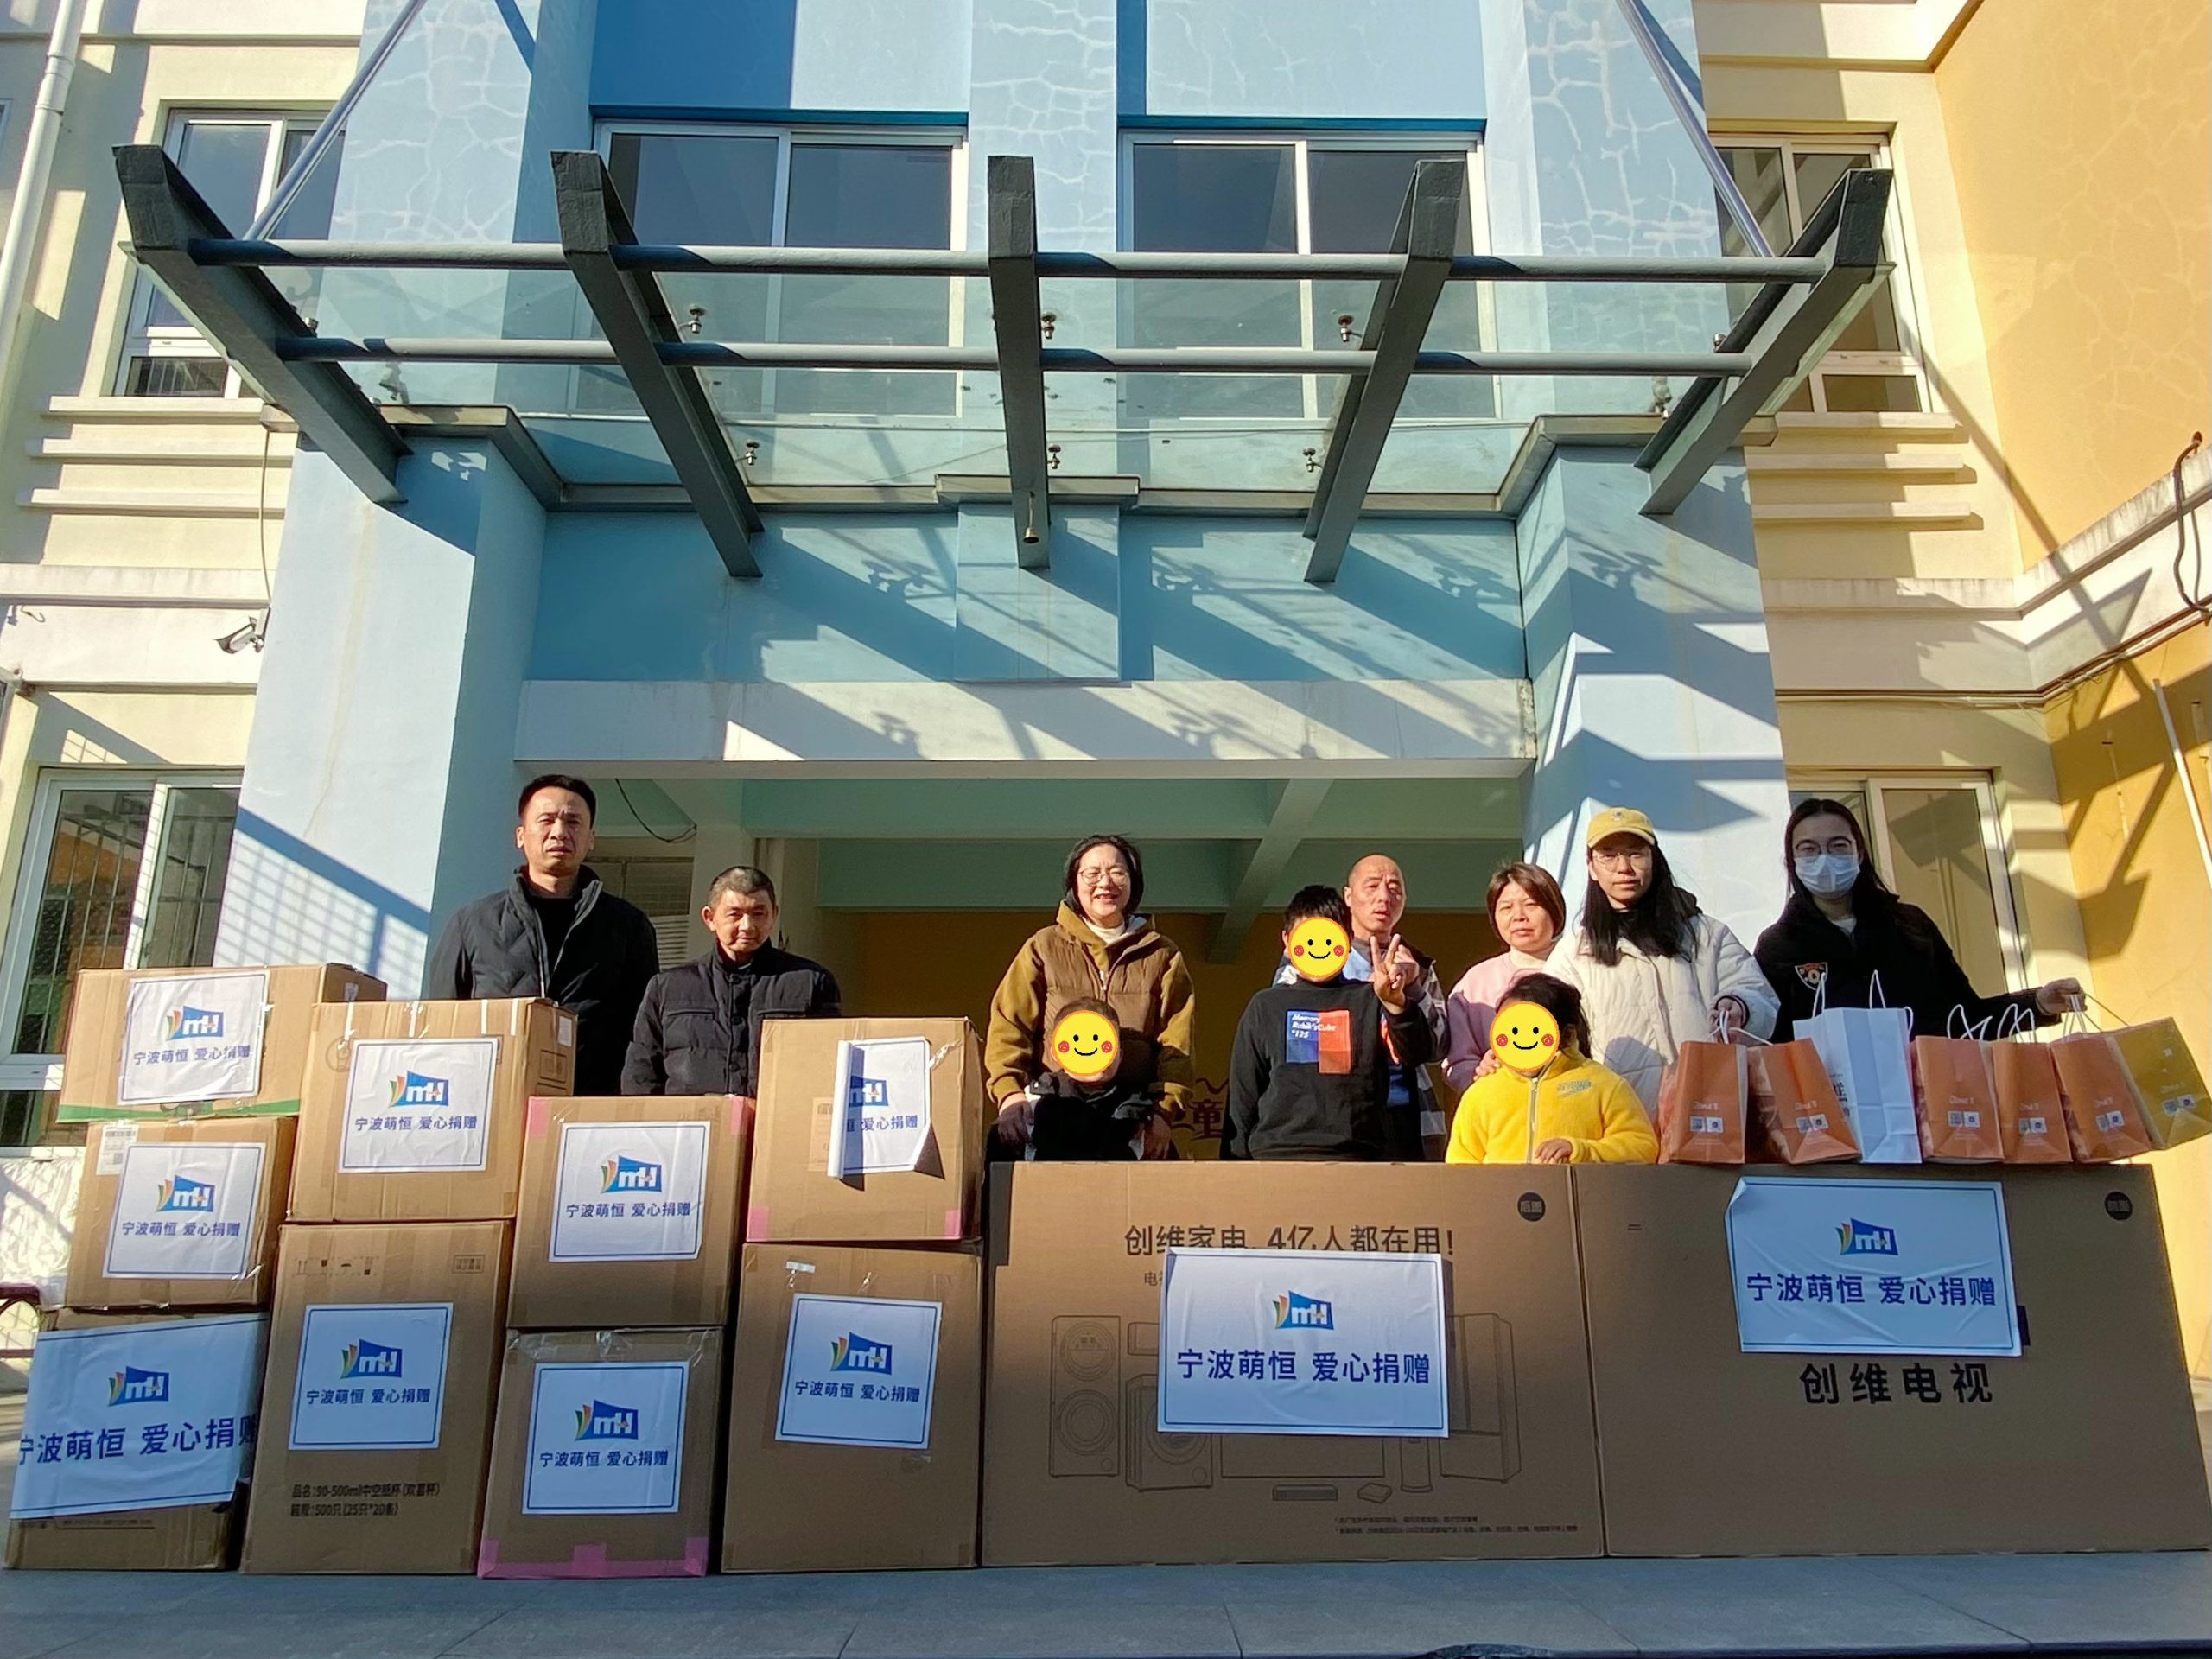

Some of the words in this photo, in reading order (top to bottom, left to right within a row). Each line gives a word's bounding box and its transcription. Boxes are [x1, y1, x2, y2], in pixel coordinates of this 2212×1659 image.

[133, 1048, 189, 1065] 宁波萌恒
[194, 1044, 251, 1061] 爱心捐赠
[355, 1116, 413, 1132] 宁波萌恒
[418, 1115, 478, 1130] 爱心捐赠
[861, 1114, 918, 1131] 爱心捐赠
[566, 1202, 625, 1218] 宁波萌恒
[631, 1201, 691, 1217] 爱心捐赠
[122, 1221, 178, 1236] 宁波萌恒
[182, 1221, 242, 1237] 爱心捐赠
[1144, 1271, 1163, 1287] 电
[1745, 1272, 1866, 1304] 宁波萌恒
[1878, 1275, 1996, 1306] 爱心捐赠
[1176, 1348, 1297, 1381] 宁波萌恒
[1311, 1351, 1430, 1385] 爱心捐赠
[794, 1380, 855, 1398] 宁波萌恒
[860, 1384, 920, 1402] 爱心捐赠
[1799, 1362, 1993, 1405] 创维电视
[306, 1389, 365, 1405] 宁波萌恒
[371, 1388, 431, 1404] 爱心捐赠
[539, 1451, 601, 1468] 宁波萌恒
[607, 1449, 669, 1467] 爱心捐赠
